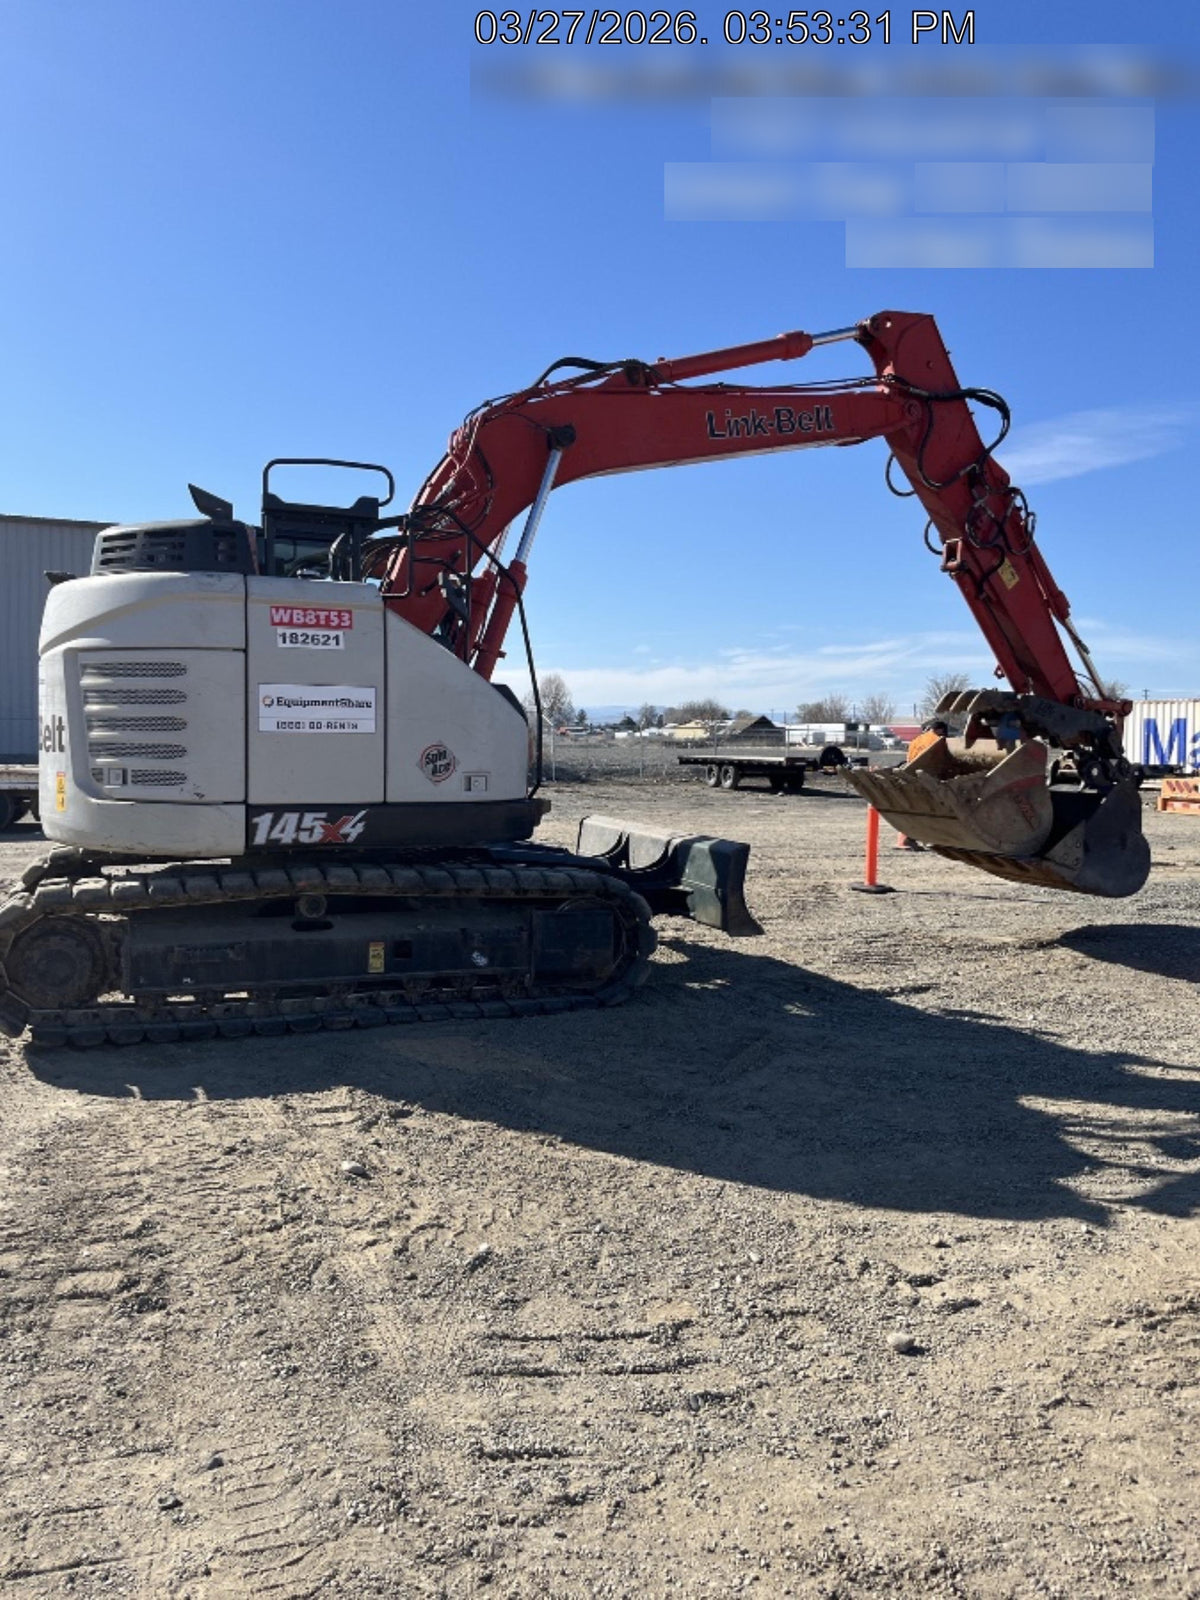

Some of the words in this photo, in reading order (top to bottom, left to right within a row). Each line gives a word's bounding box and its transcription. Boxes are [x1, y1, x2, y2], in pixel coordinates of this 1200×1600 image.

[706, 405, 834, 439] Link-Belt
[271, 607, 351, 626] WB8T53
[279, 632, 340, 646] 182621
